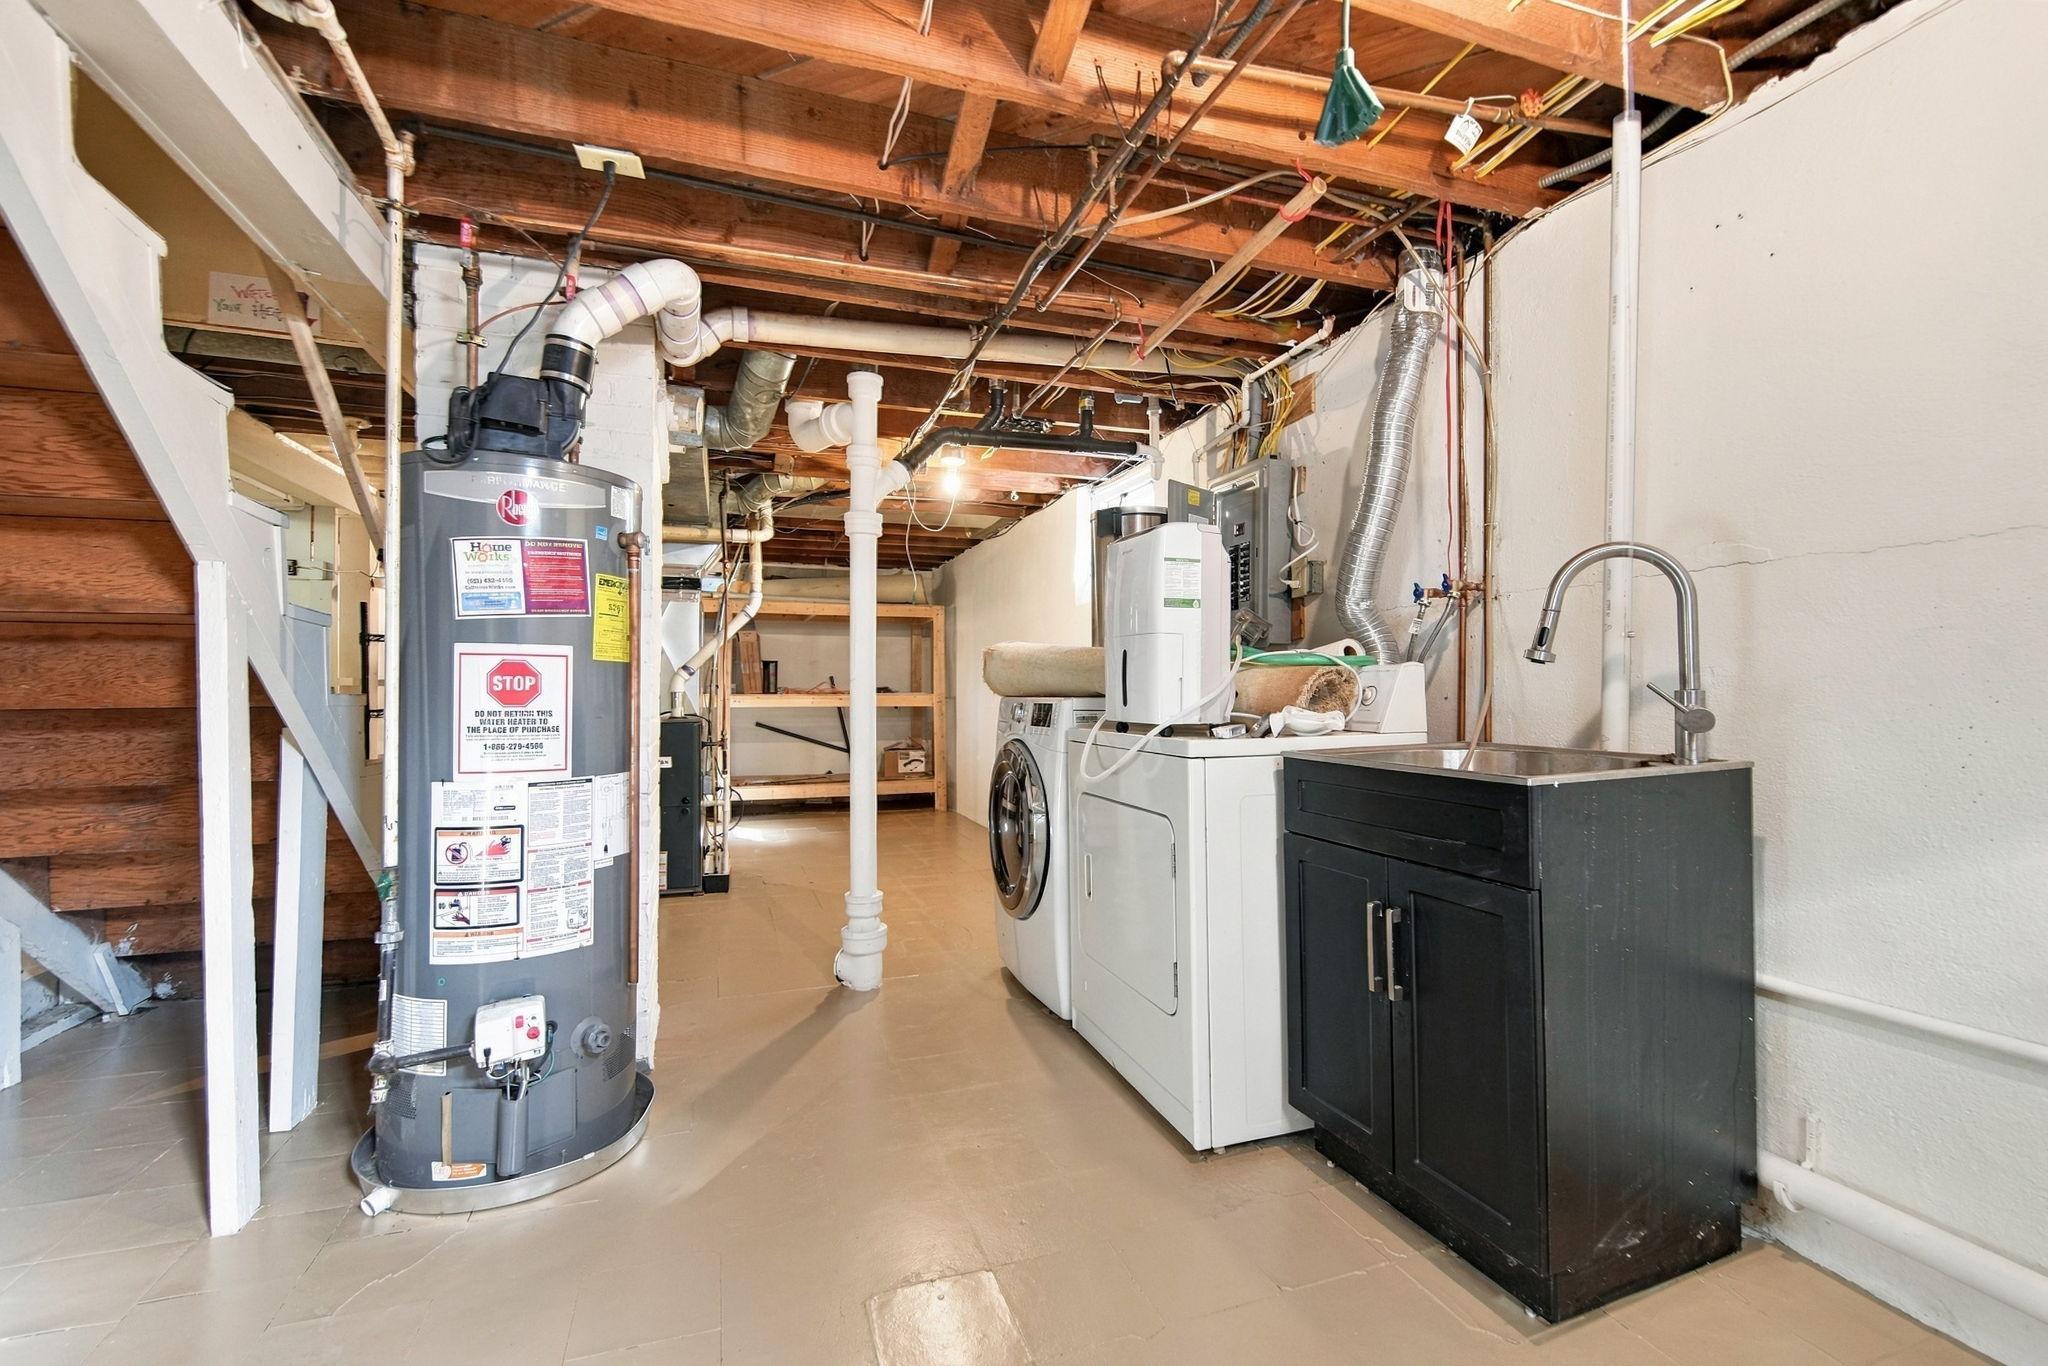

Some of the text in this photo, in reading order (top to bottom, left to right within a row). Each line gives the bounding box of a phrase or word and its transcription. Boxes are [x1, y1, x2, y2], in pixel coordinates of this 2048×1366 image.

[470, 542, 512, 552] Home
[464, 551, 510, 562] Works
[492, 675, 536, 691] STOP
[474, 710, 485, 718] DO
[487, 710, 502, 718] NOT
[504, 710, 534, 718] RETURN
[479, 718, 505, 726] WATER
[466, 726, 481, 734] THE
[482, 726, 507, 734] PLACE
[521, 725, 560, 733] PURCHASE
